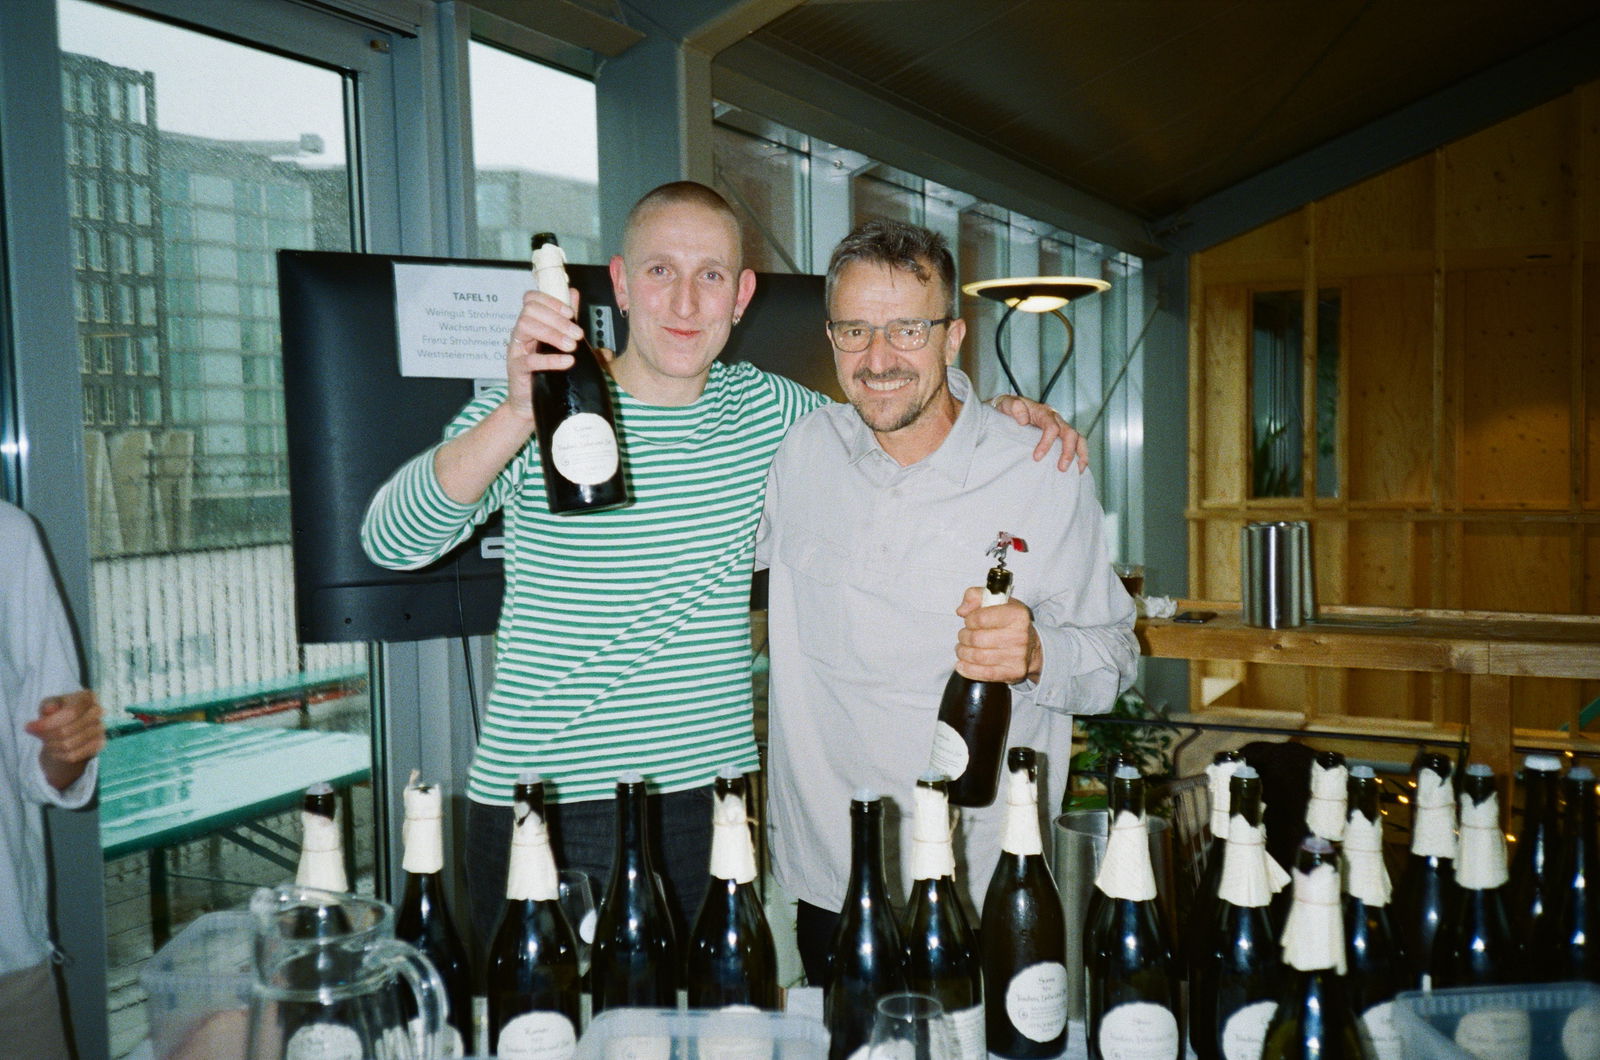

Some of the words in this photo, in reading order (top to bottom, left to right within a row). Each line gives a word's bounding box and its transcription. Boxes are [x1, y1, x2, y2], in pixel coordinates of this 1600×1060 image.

[452, 292, 484, 302] TAFEL
[486, 294, 498, 303] 10
[425, 307, 465, 320] Weingut
[467, 309, 517, 321] Strohmeier
[439, 322, 487, 333] Wachstum
[422, 334, 447, 345] Franz
[449, 336, 500, 346] Strohmeier
[416, 349, 491, 360] Weststeiermark,
